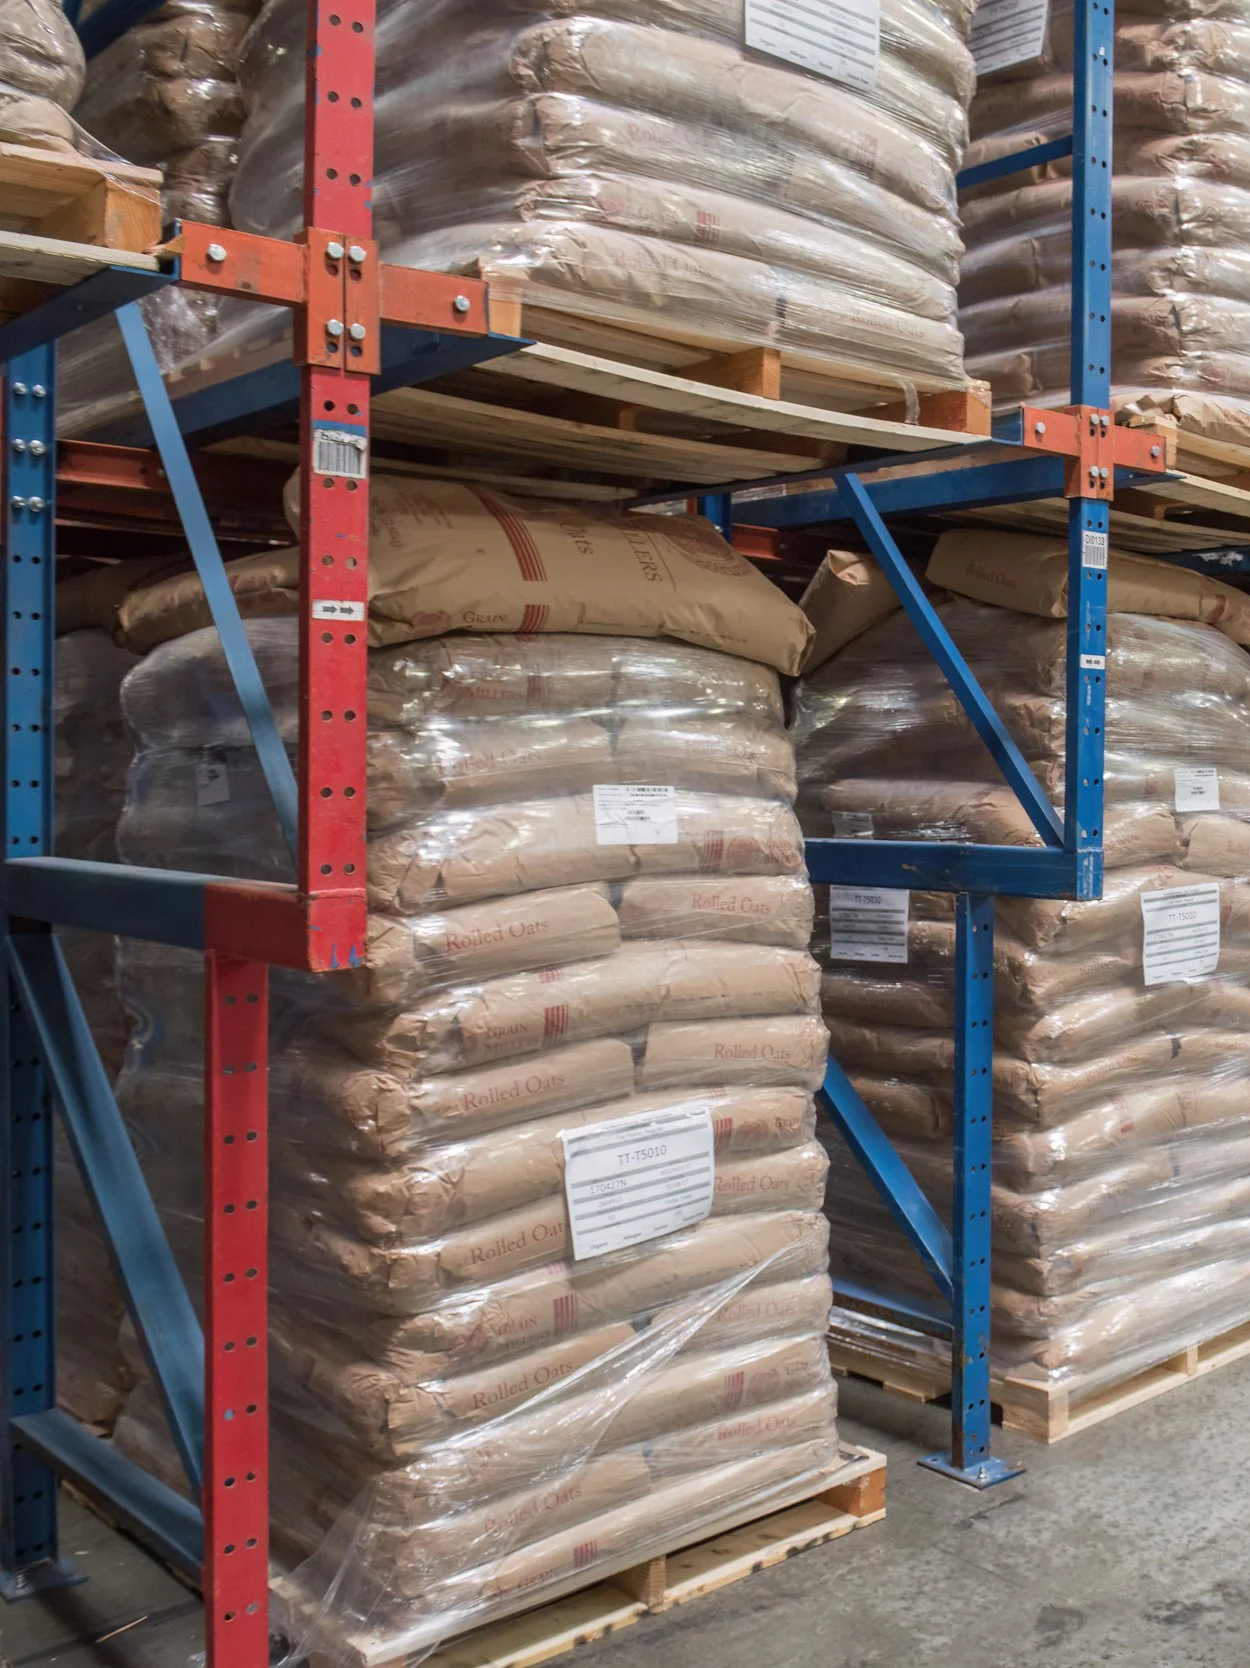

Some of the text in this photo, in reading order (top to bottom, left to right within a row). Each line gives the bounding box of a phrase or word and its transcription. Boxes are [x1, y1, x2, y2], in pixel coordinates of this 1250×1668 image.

[691, 892, 770, 914] Rolled Oats
[445, 920, 548, 952] Rolled Oats
[714, 1043, 791, 1060] Rolled Oats
[462, 1073, 566, 1112] Rolled Oats
[617, 1144, 668, 1166] TT-T5010
[590, 1178, 627, 1195] 170427N
[714, 1175, 790, 1194] Rolled Oats
[469, 1222, 566, 1264] Rolled Oat
[717, 1301, 795, 1322] Rolled Oats
[472, 1361, 573, 1409] Rolled Oats
[544, 1488, 581, 1510] Oats
